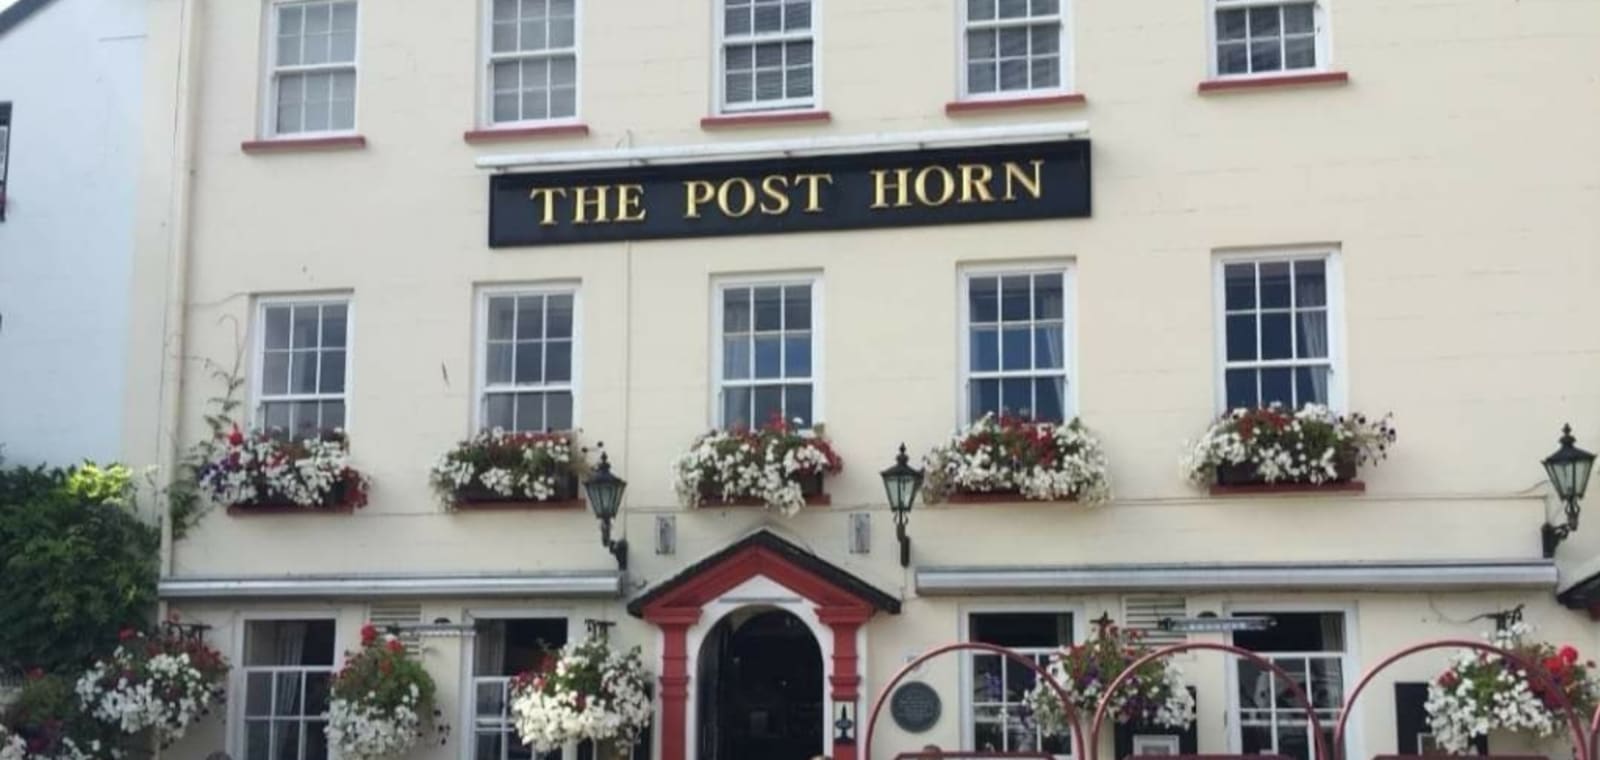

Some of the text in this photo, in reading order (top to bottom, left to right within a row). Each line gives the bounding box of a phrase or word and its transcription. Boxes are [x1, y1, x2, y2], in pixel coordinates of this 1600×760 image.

[531, 160, 1044, 225] THE POST HORN
